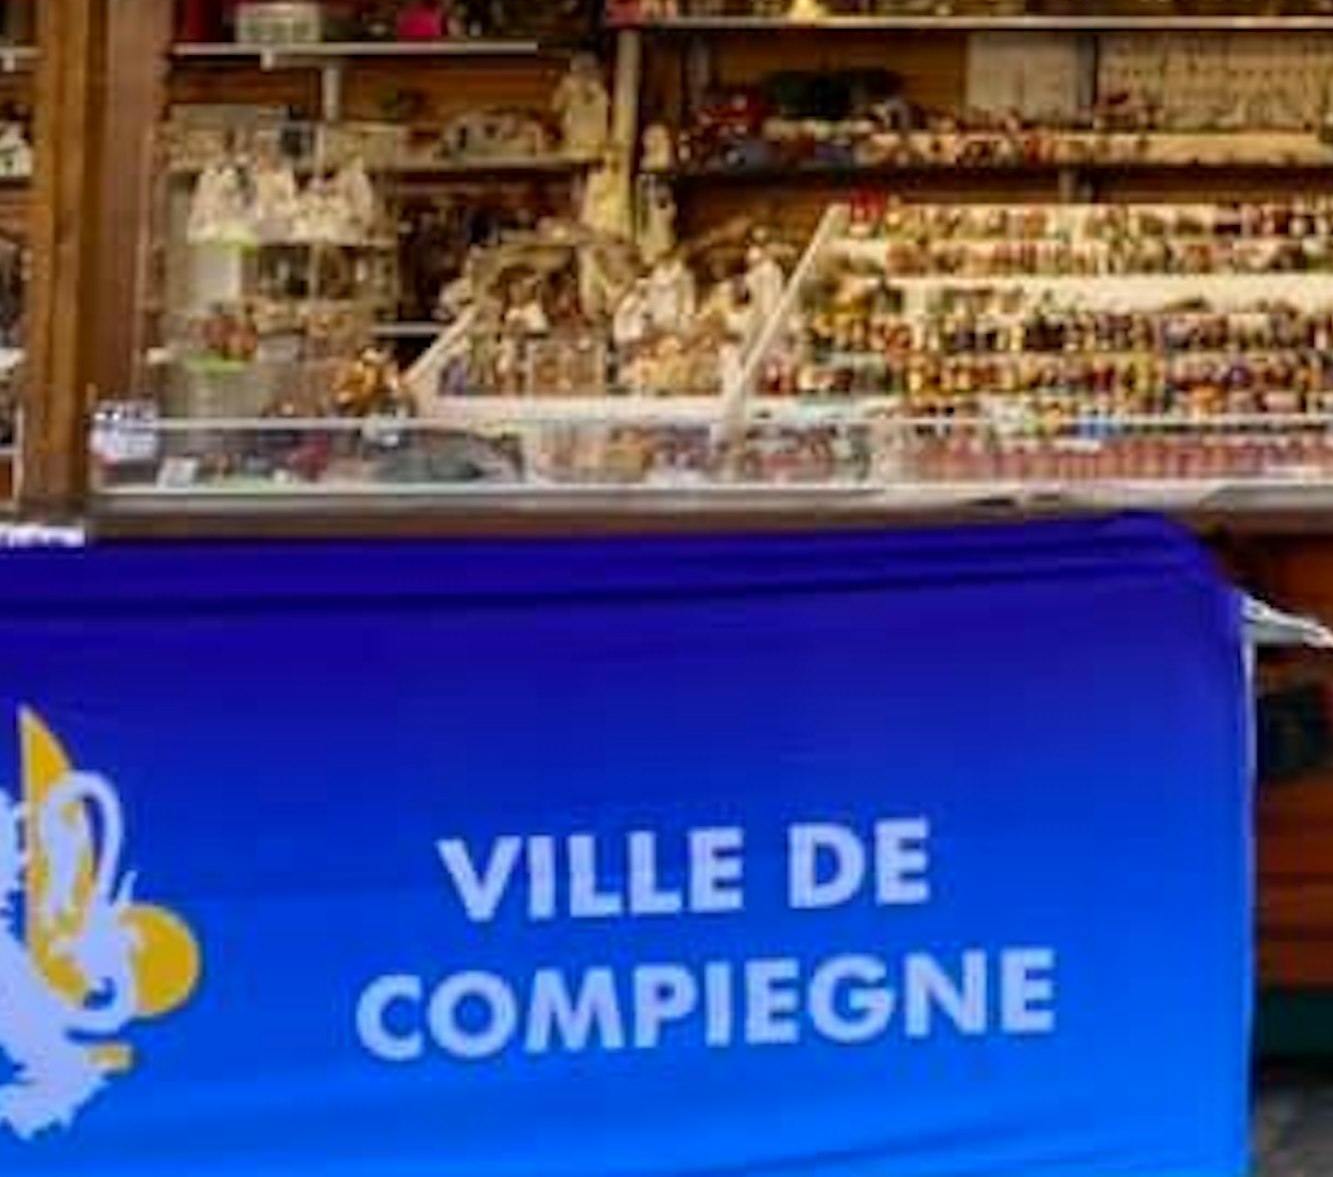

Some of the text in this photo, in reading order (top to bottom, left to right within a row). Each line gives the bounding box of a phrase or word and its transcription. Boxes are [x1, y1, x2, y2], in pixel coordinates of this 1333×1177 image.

[437, 818, 931, 921] VILLE DE
[354, 947, 1056, 1061] COMPIEGNE
